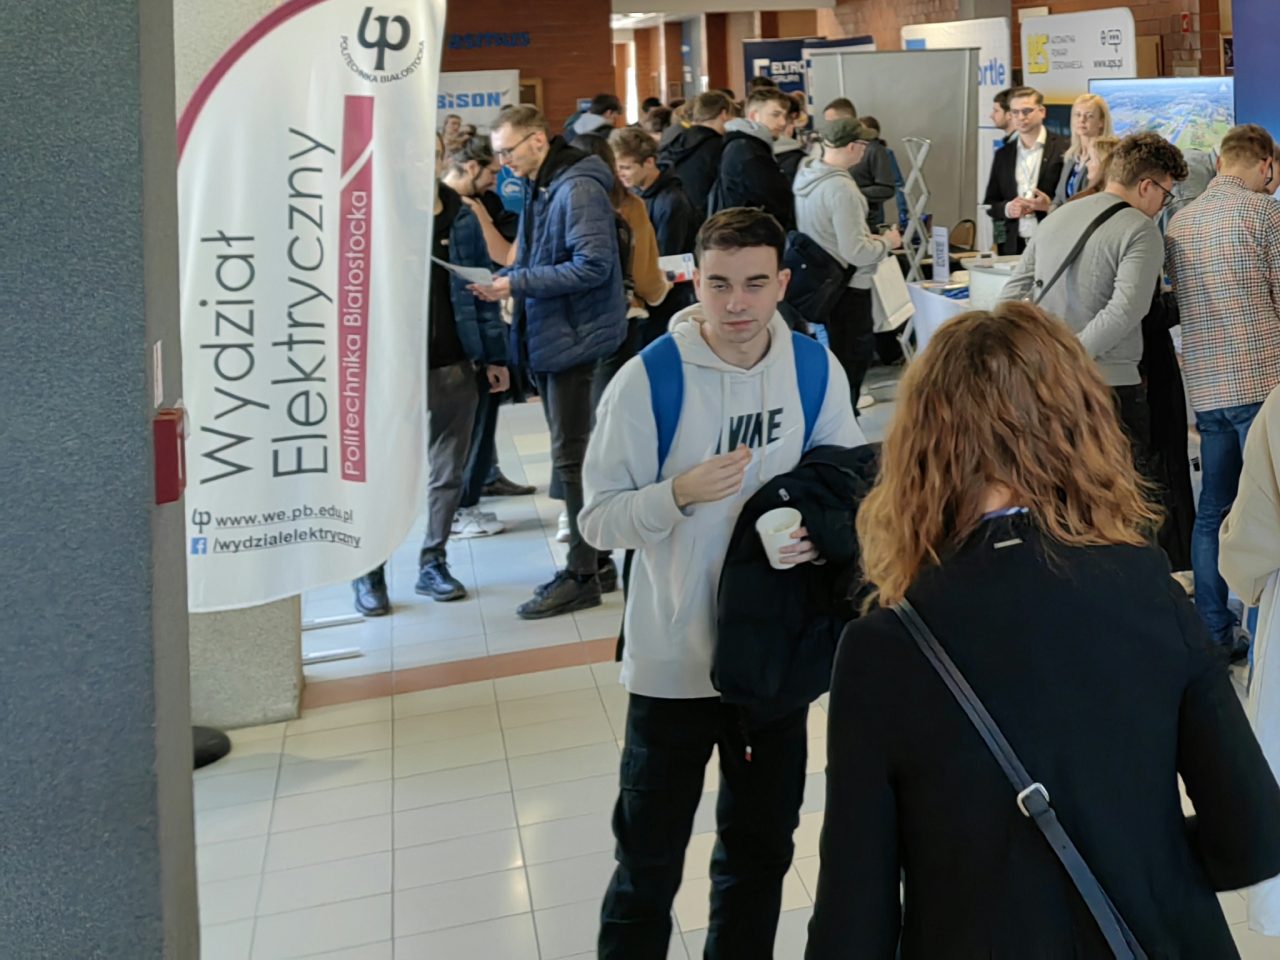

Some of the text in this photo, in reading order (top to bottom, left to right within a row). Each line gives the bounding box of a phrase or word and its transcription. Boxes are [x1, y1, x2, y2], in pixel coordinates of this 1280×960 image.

[199, 230, 270, 485] Wydział
[271, 127, 335, 477] Elektryczny
[343, 190, 368, 476] Politechnika Białostocka
[213, 527, 361, 553] /wydzialelektryczny
[215, 504, 353, 528] www.we.pb.edu.pl
